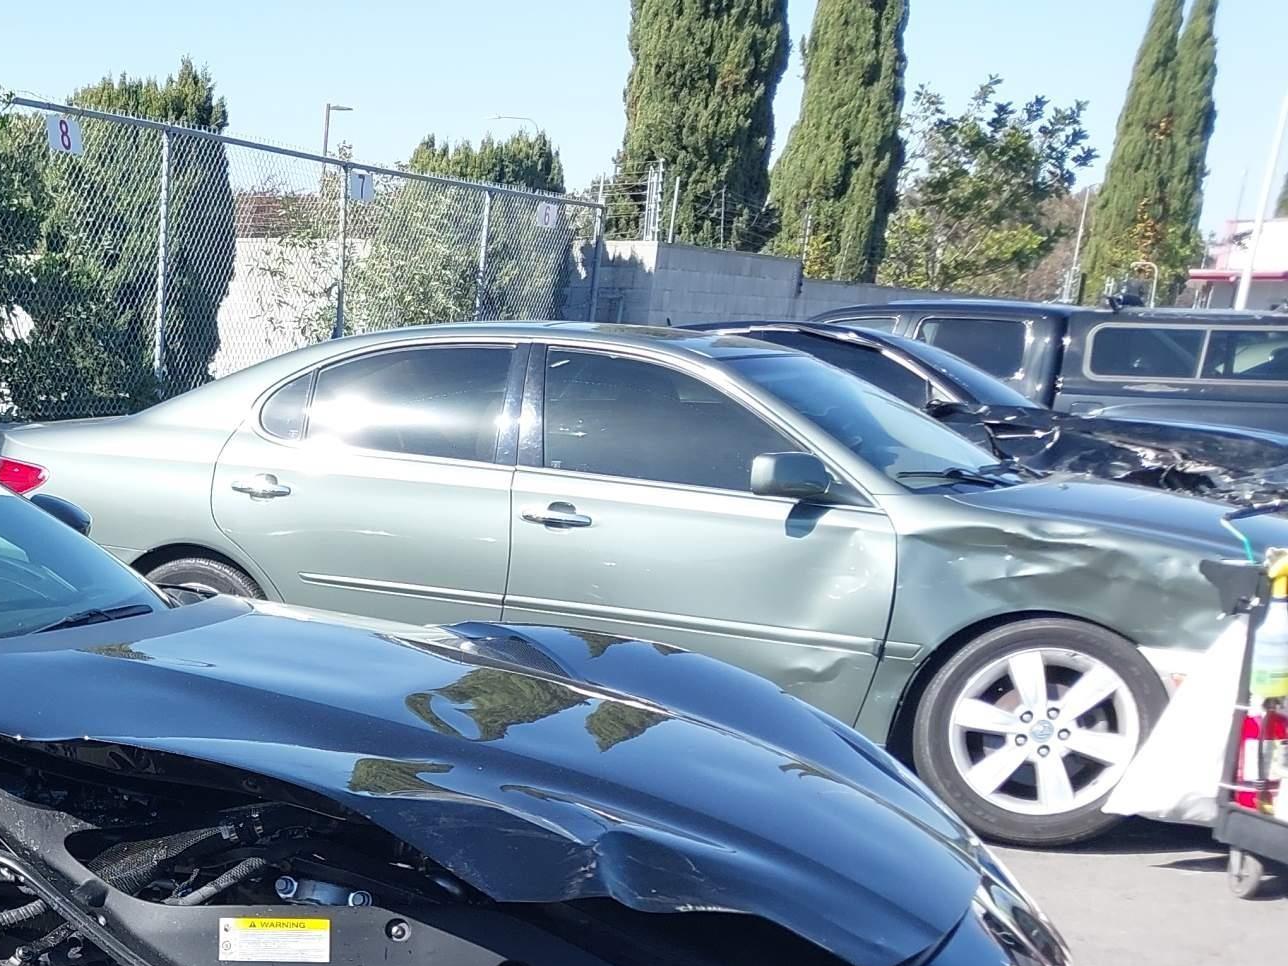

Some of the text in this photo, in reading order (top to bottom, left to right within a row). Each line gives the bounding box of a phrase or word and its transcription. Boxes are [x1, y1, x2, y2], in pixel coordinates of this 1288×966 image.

[59, 119, 72, 151] 8
[357, 173, 366, 200] 7
[543, 205, 551, 226] 6
[260, 920, 306, 929] WARNING
